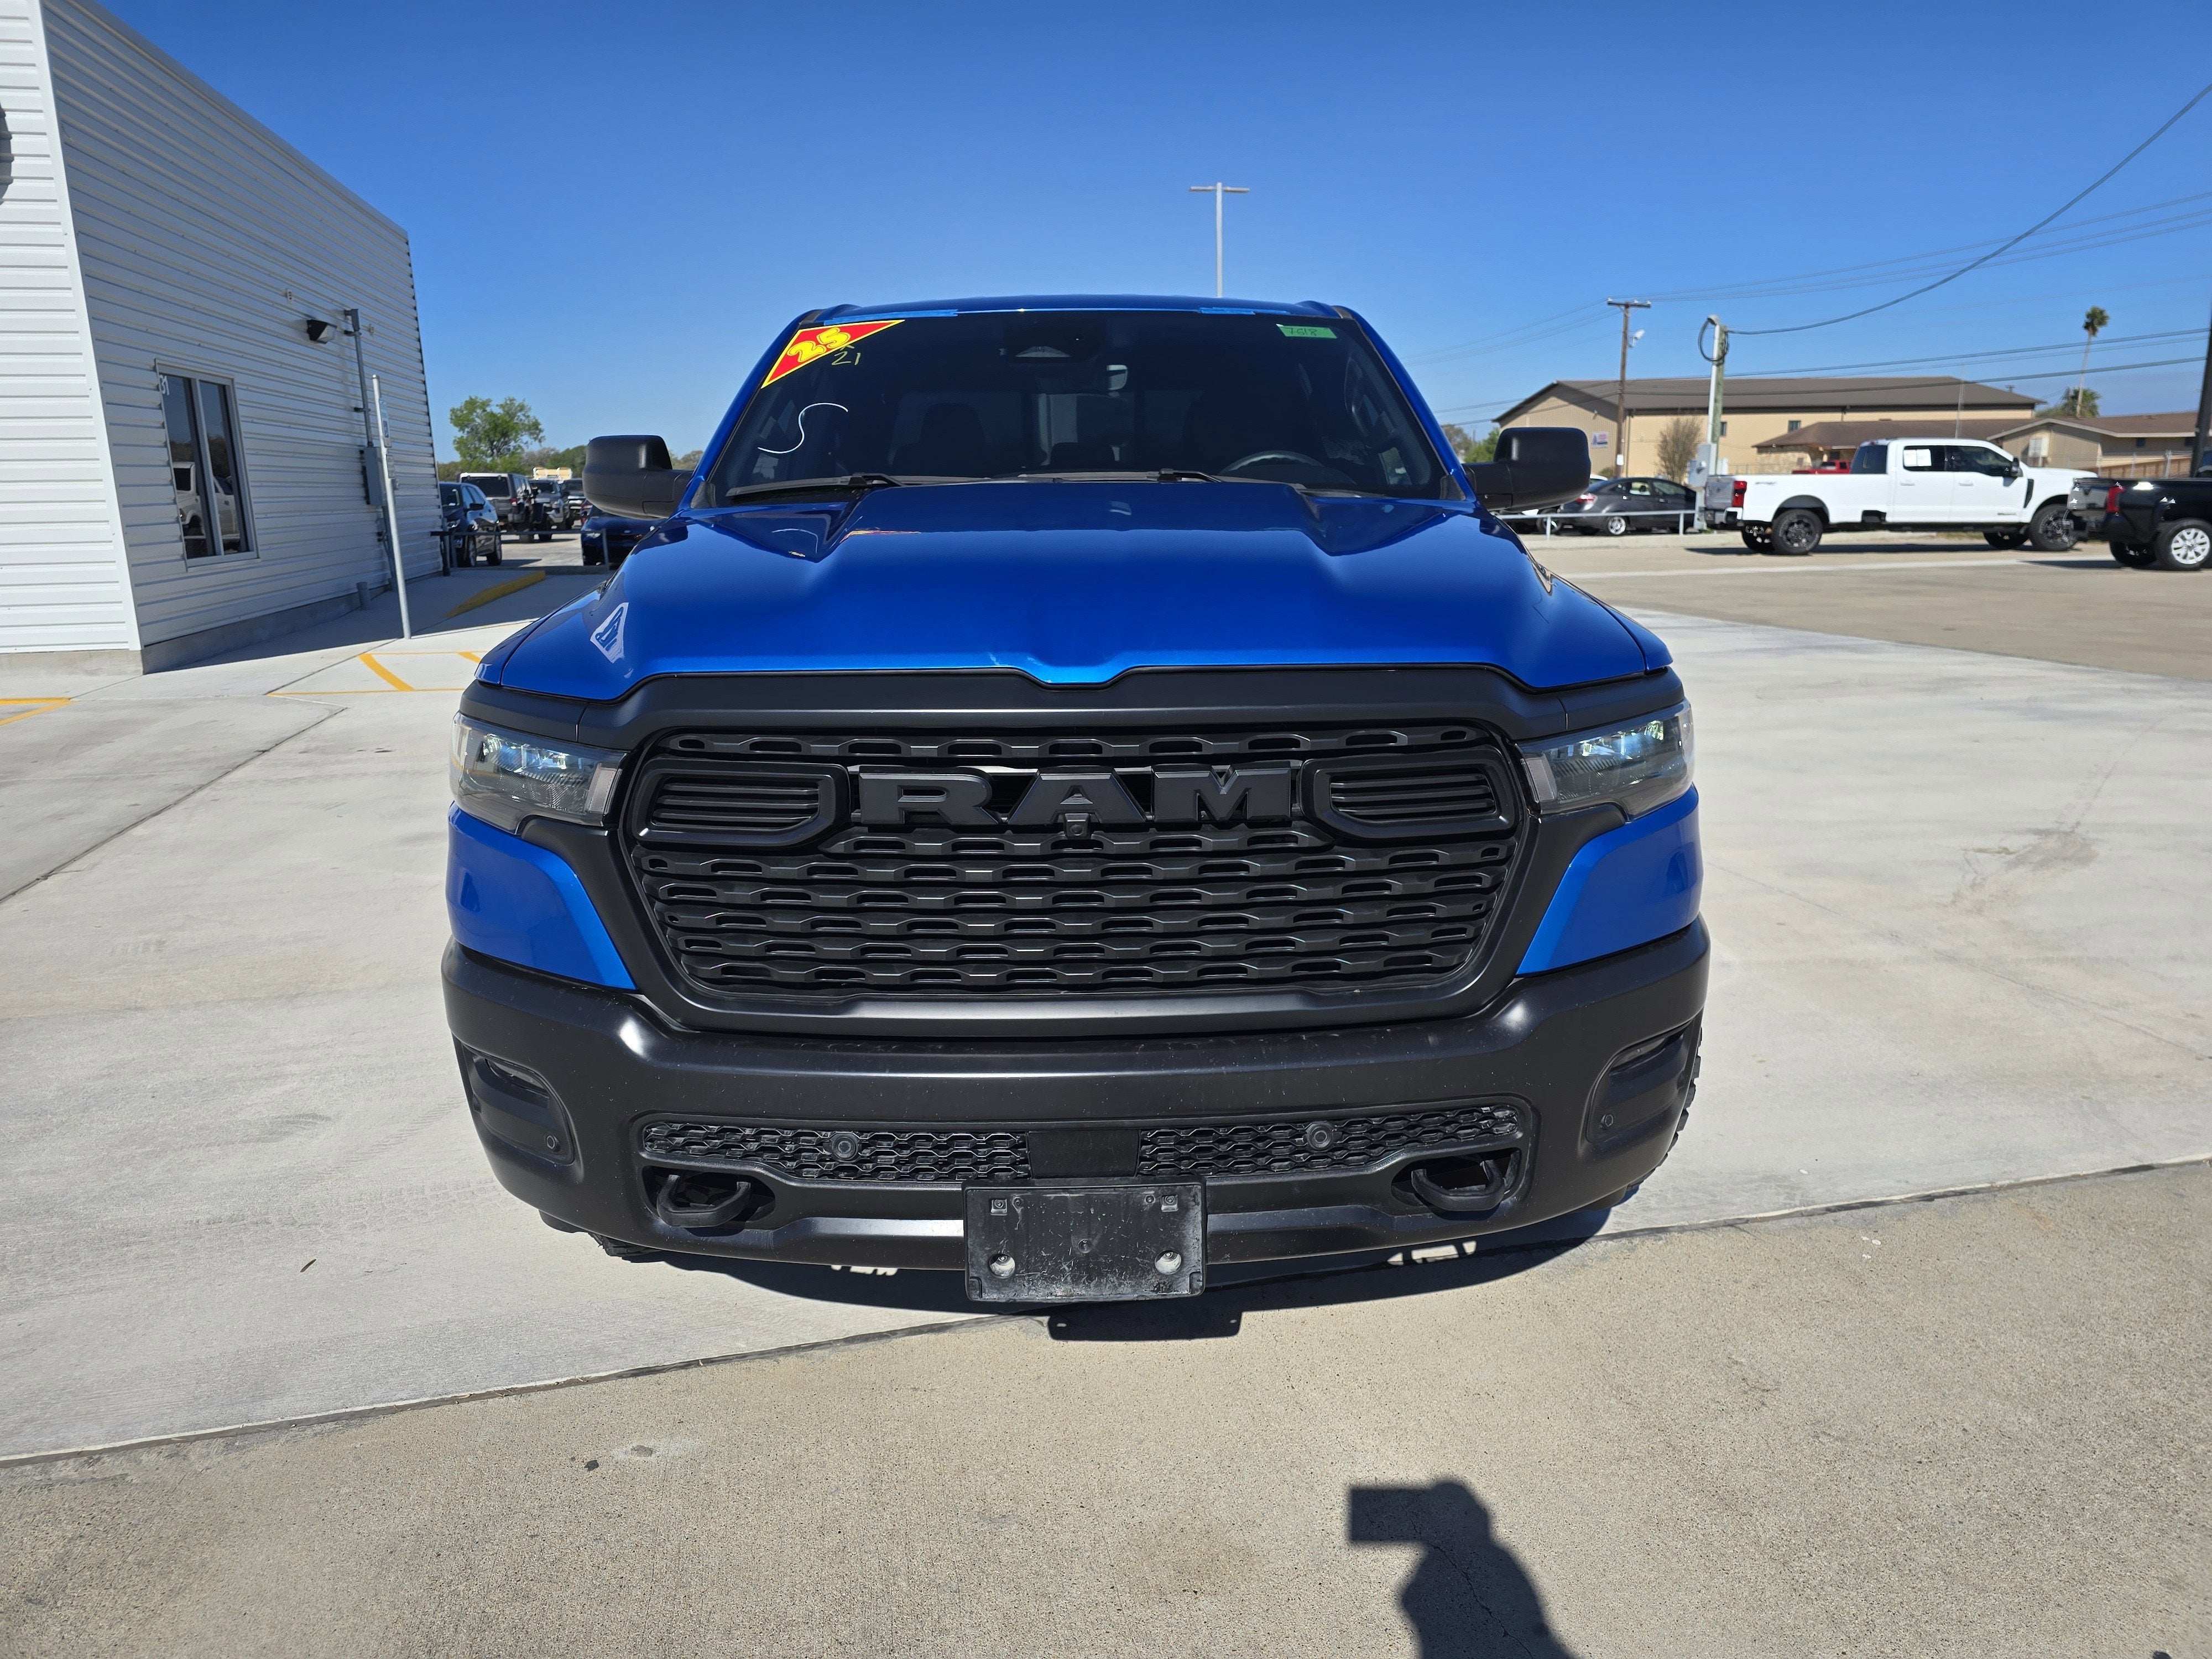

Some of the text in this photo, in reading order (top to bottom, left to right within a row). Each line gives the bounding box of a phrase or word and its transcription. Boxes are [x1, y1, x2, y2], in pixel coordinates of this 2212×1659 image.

[786, 326, 852, 363] 25
[831, 351, 861, 366] 21
[858, 761, 1292, 826] RAM
